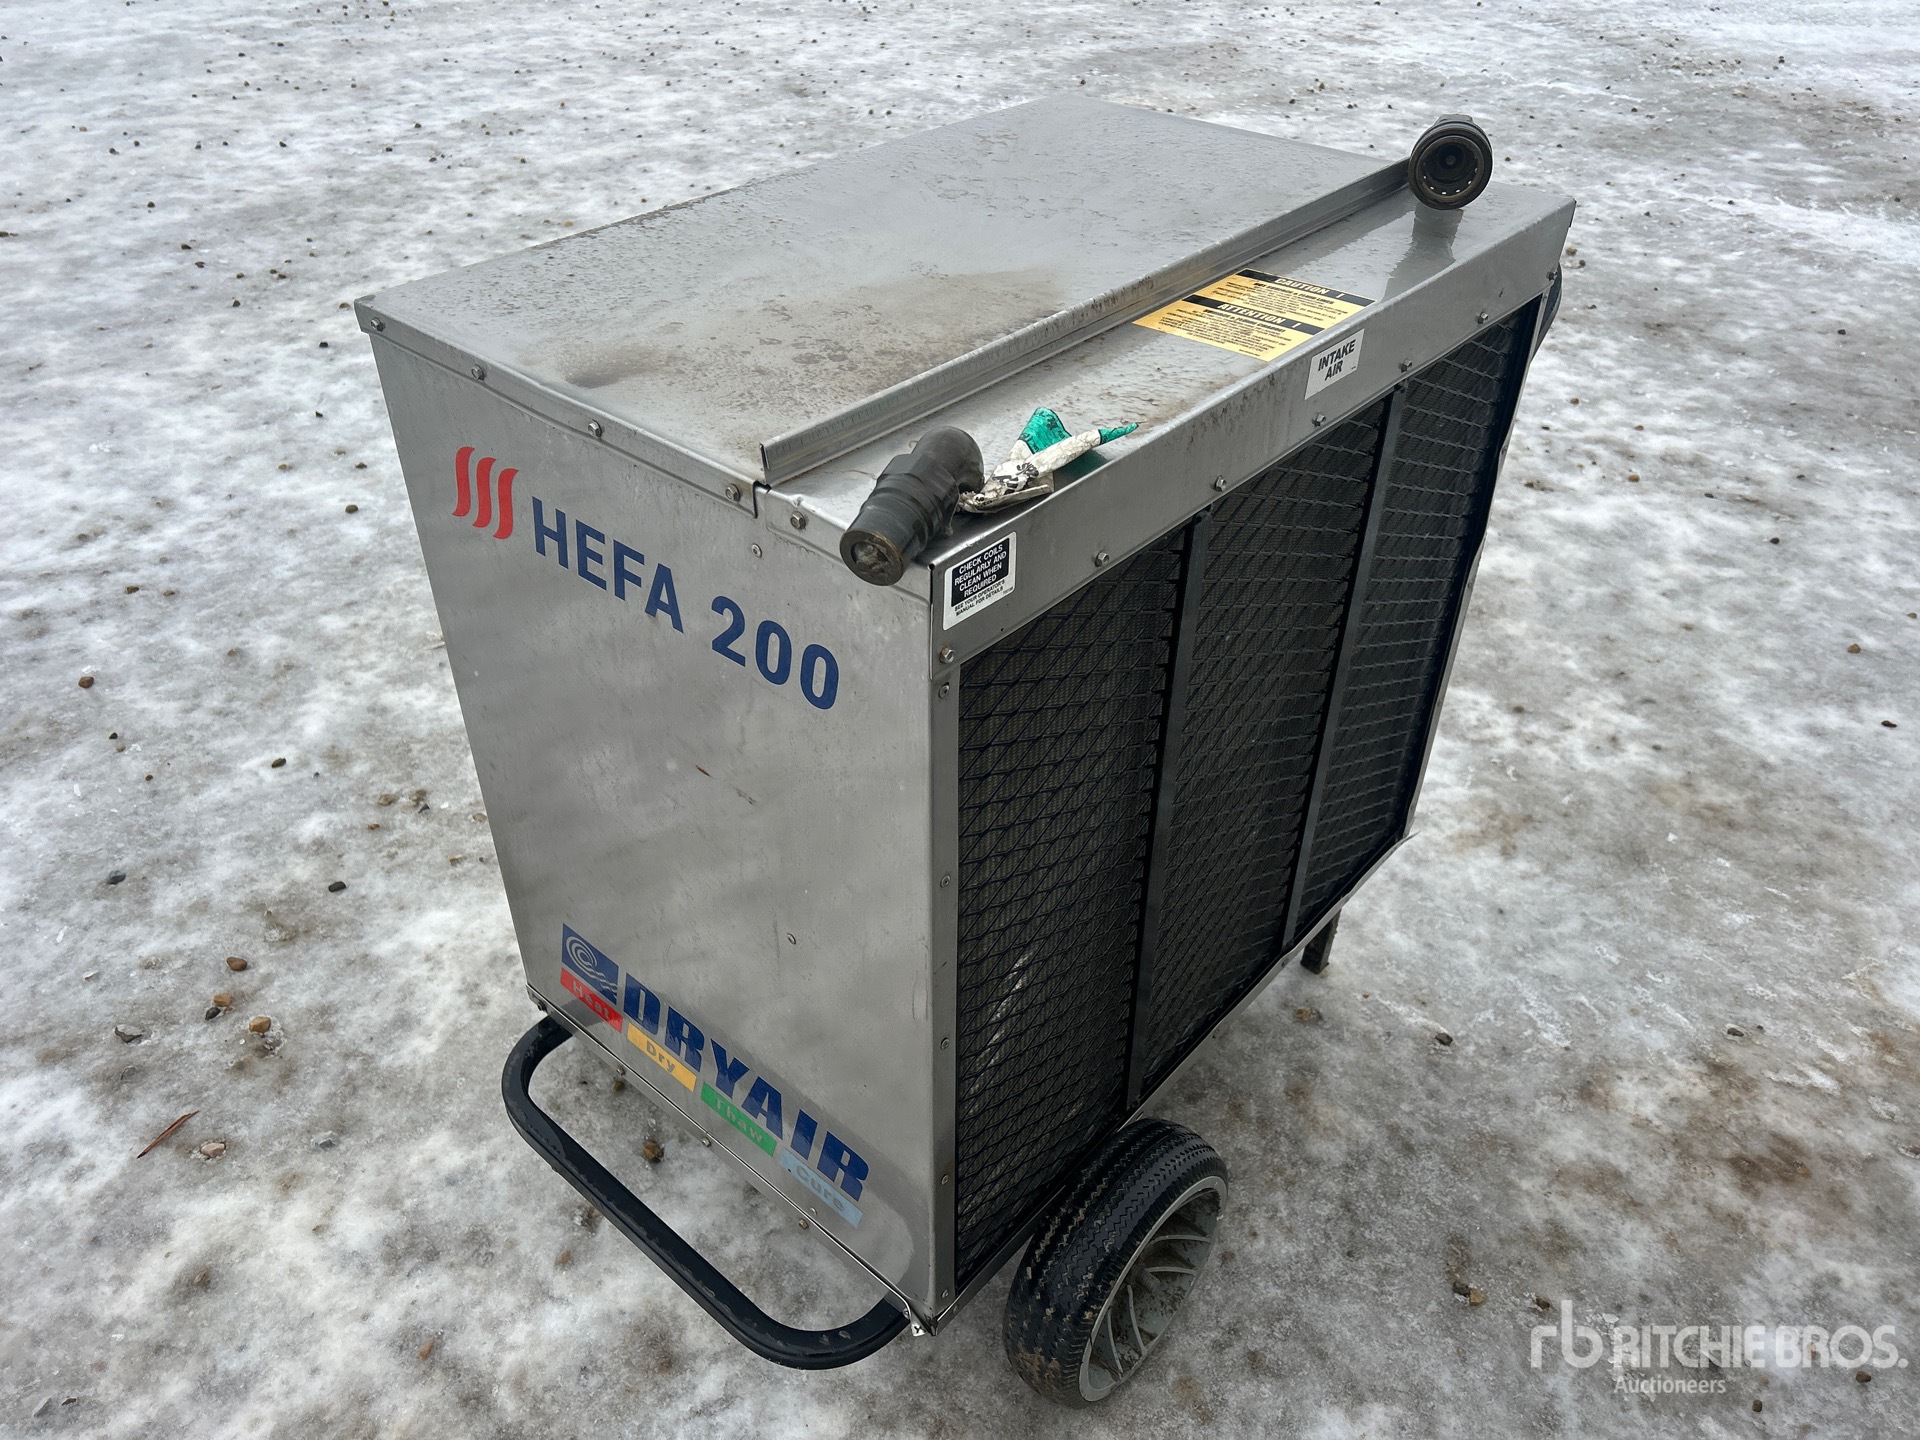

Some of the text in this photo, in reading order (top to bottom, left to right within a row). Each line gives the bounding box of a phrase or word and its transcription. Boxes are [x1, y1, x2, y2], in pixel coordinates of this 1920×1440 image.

[1274, 279, 1330, 295] CAUTION
[1217, 303, 1286, 324] ATTENTION
[1318, 339, 1356, 371] INTAKE
[1324, 360, 1344, 381] AIR
[954, 551, 1007, 586] REGULARLY AND
[958, 544, 1003, 575] CHECK COILS
[959, 574, 982, 592] CLEAN
[982, 562, 1002, 579] WHEN
[963, 574, 997, 598] REQUIRED
[532, 496, 840, 710] HEFA 200
[573, 981, 610, 1020] Heat
[646, 1041, 676, 1073] Dry
[623, 972, 869, 1202] DRYAIR
[714, 1094, 762, 1142] Thaw
